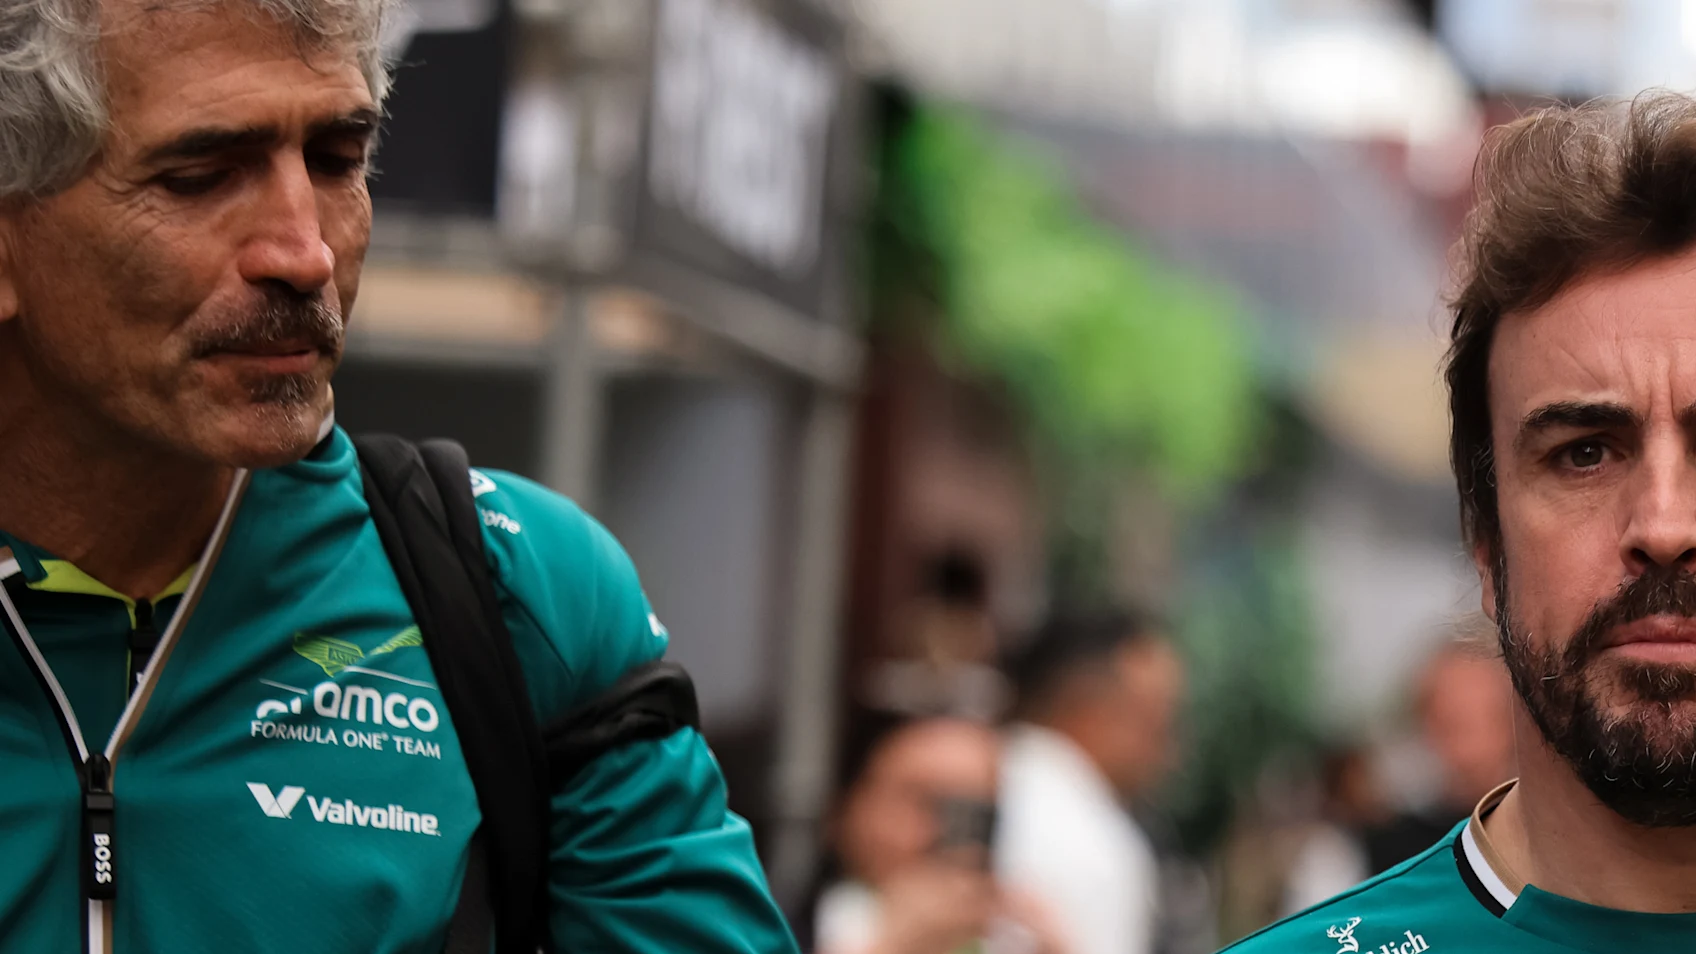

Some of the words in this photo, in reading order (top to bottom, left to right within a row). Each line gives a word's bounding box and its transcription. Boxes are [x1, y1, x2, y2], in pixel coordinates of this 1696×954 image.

[251, 719, 339, 746] FORMULA
[393, 734, 441, 760] TEAM
[306, 795, 442, 837] Valvoline
[94, 832, 113, 884] BOSS
